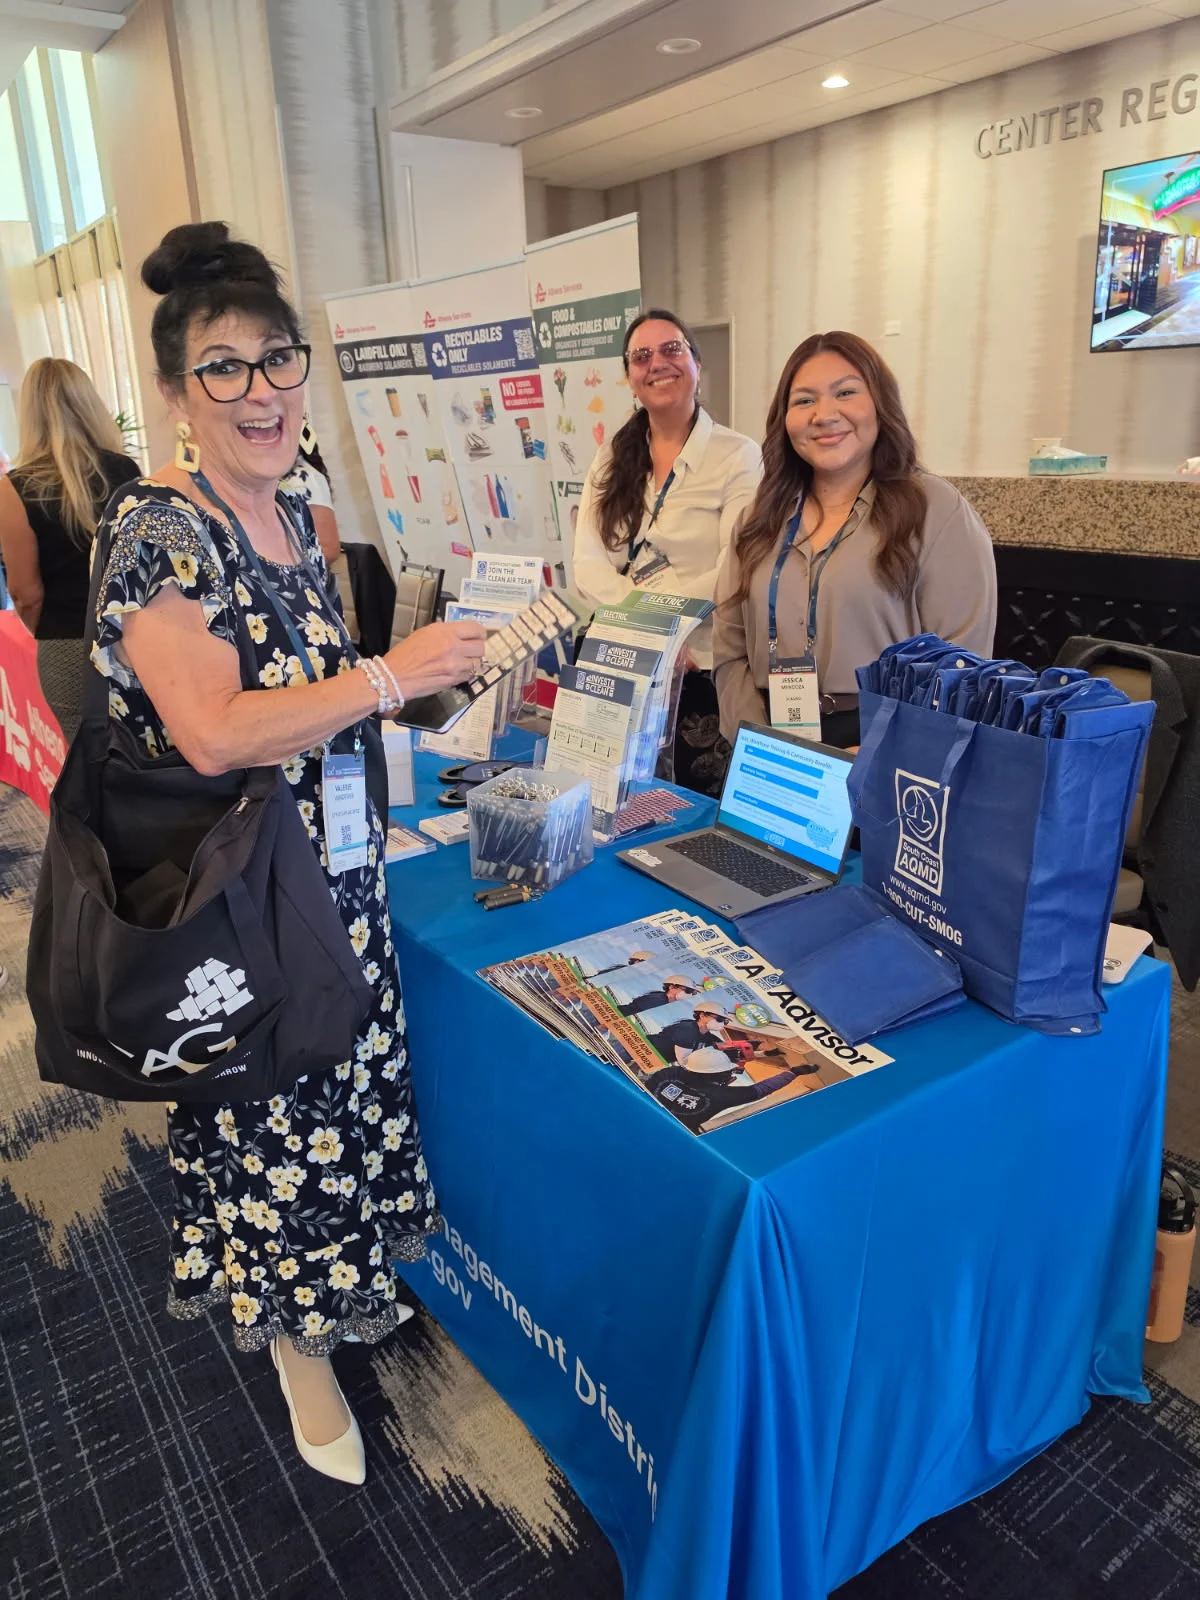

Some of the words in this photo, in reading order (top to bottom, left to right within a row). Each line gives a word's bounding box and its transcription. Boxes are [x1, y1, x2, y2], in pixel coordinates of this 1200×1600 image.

[975, 96, 1104, 160] CENTER
[1119, 72, 1198, 128] REG
[551, 308, 570, 324] FOOD
[553, 319, 603, 338] COMPOSTABLES
[602, 315, 622, 332] ONLY
[444, 325, 503, 348] RECYCLABLES
[353, 344, 389, 362] LANDFILL
[388, 343, 408, 358] ONLY
[447, 347, 468, 363] ONLY
[482, 358, 517, 372] SOLAMENTE
[501, 381, 516, 397] NO
[487, 574, 506, 583] CLEAN
[506, 576, 517, 584] AIR
[488, 566, 503, 574] JOIN
[647, 594, 686, 606] ELECTRIC
[603, 609, 629, 621] ELECTRIC
[610, 656, 629, 668] CLEAN
[589, 684, 609, 697] CLEAN
[902, 841, 921, 859] South
[920, 850, 940, 869] Coast
[899, 852, 939, 886] AQMD
[889, 874, 947, 914] www.aqmd.gov
[766, 990, 875, 1066] Advisor
[612, 1022, 624, 1036] HELPS
[622, 1032, 639, 1051] REBUILD
[634, 1048, 655, 1069] ALTADENA
[629, 1029, 643, 1044] COAST
[640, 1040, 653, 1055] AQMD
[426, 1248, 473, 1311] .gov
